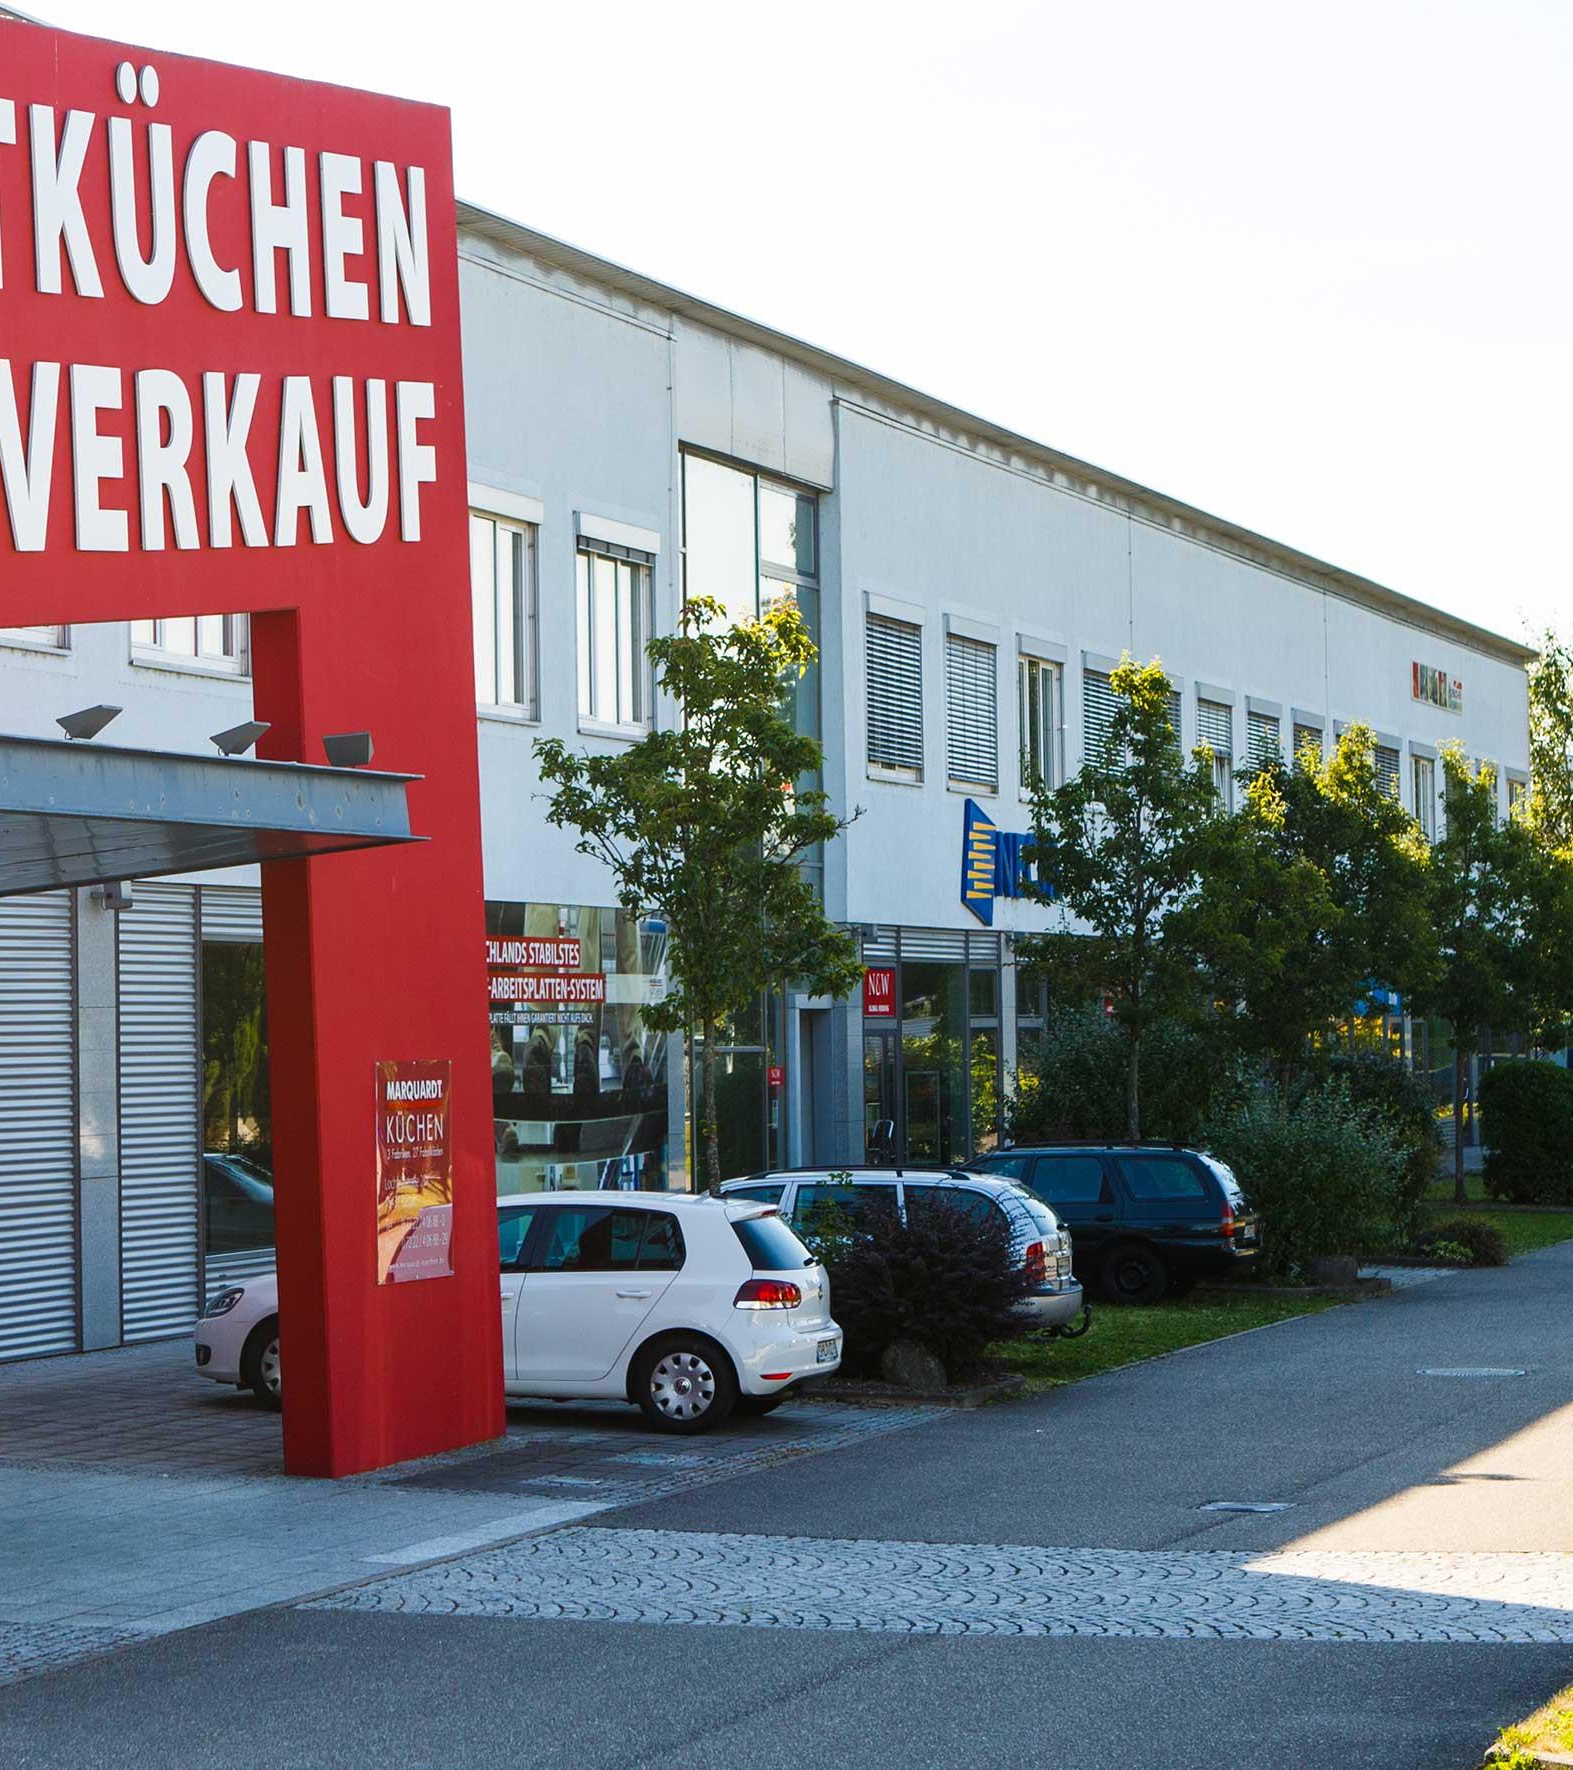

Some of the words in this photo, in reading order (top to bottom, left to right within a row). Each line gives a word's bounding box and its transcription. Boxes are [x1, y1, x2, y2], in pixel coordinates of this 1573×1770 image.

[529, 942, 580, 965] STABILSTES
[386, 1080, 442, 1101] MARQUARDT
[386, 1111, 443, 1143] KÜCHEN
